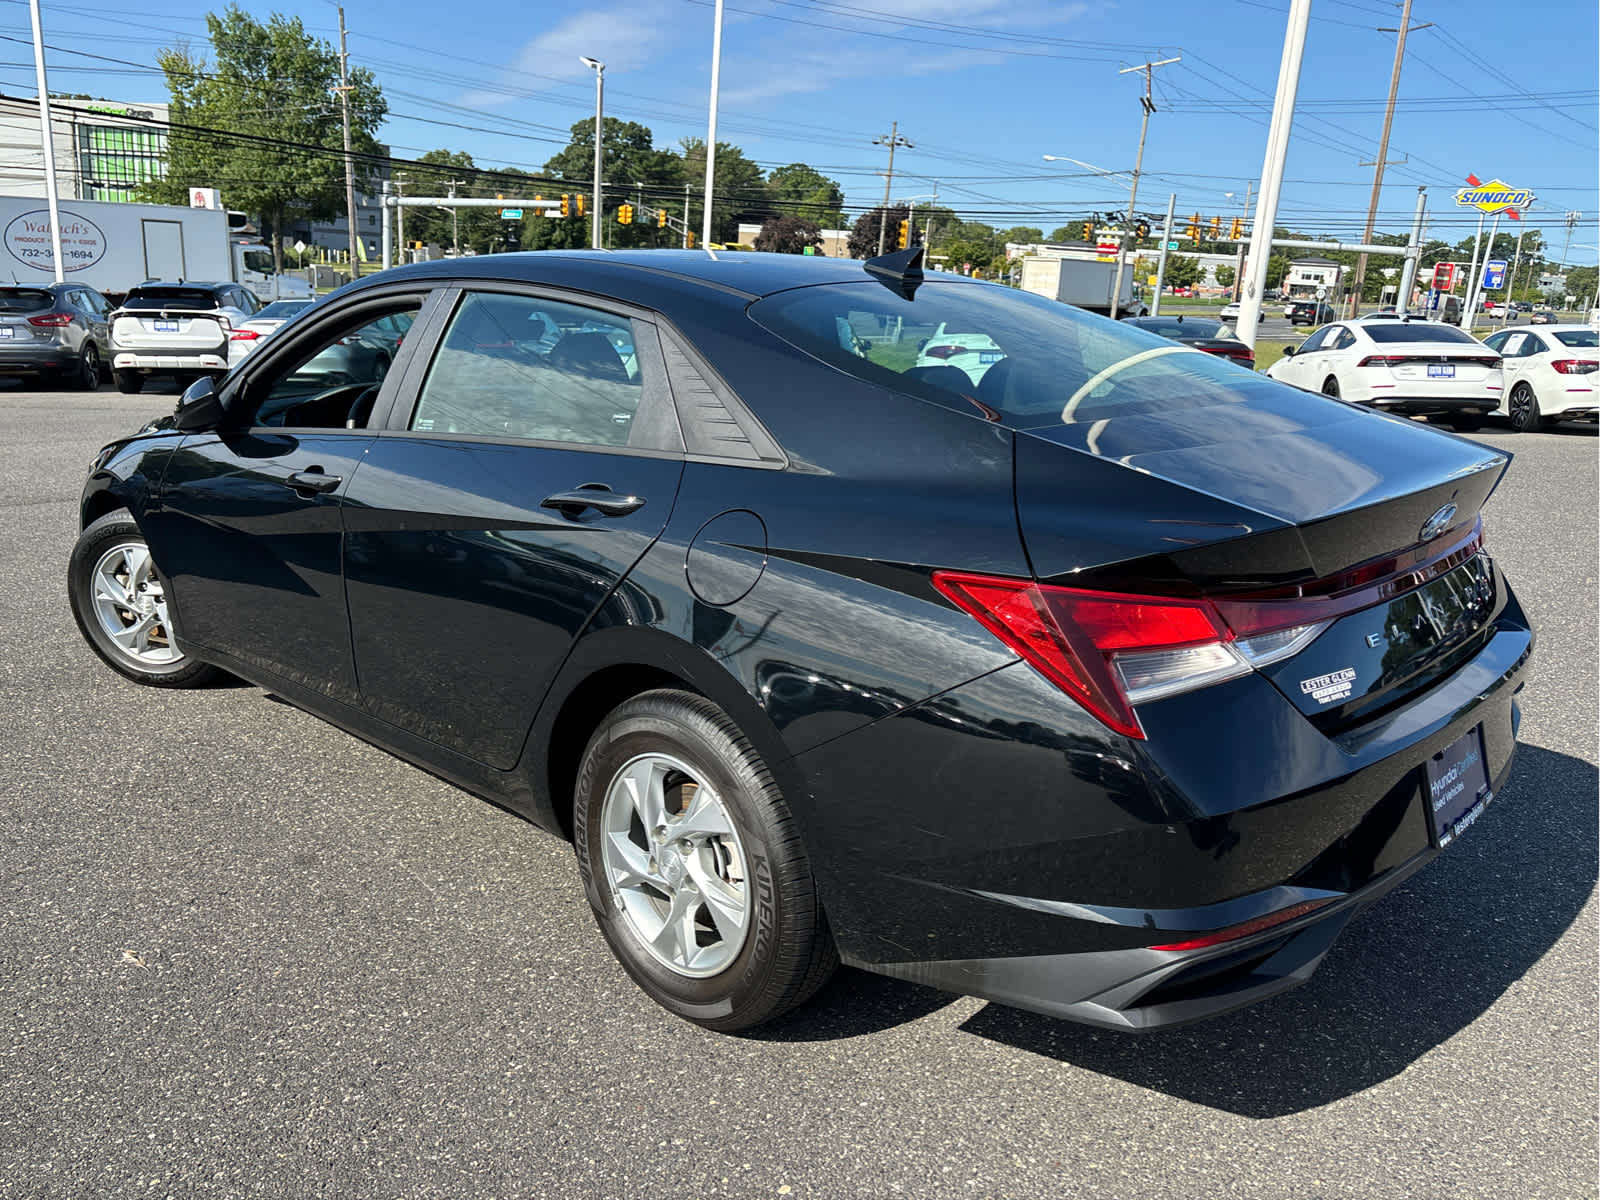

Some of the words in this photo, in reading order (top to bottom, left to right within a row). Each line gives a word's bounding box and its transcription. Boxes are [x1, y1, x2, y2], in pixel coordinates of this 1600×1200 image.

[1461, 192, 1525, 203] SUNOCO
[23, 220, 90, 235] Walch's
[21, 248, 93, 259] 732-34-1694
[1301, 676, 1331, 691] LESTER
[1331, 669, 1356, 684] GLENN
[1430, 766, 1458, 798] Hyundai
[752, 853, 773, 961] KINERG
